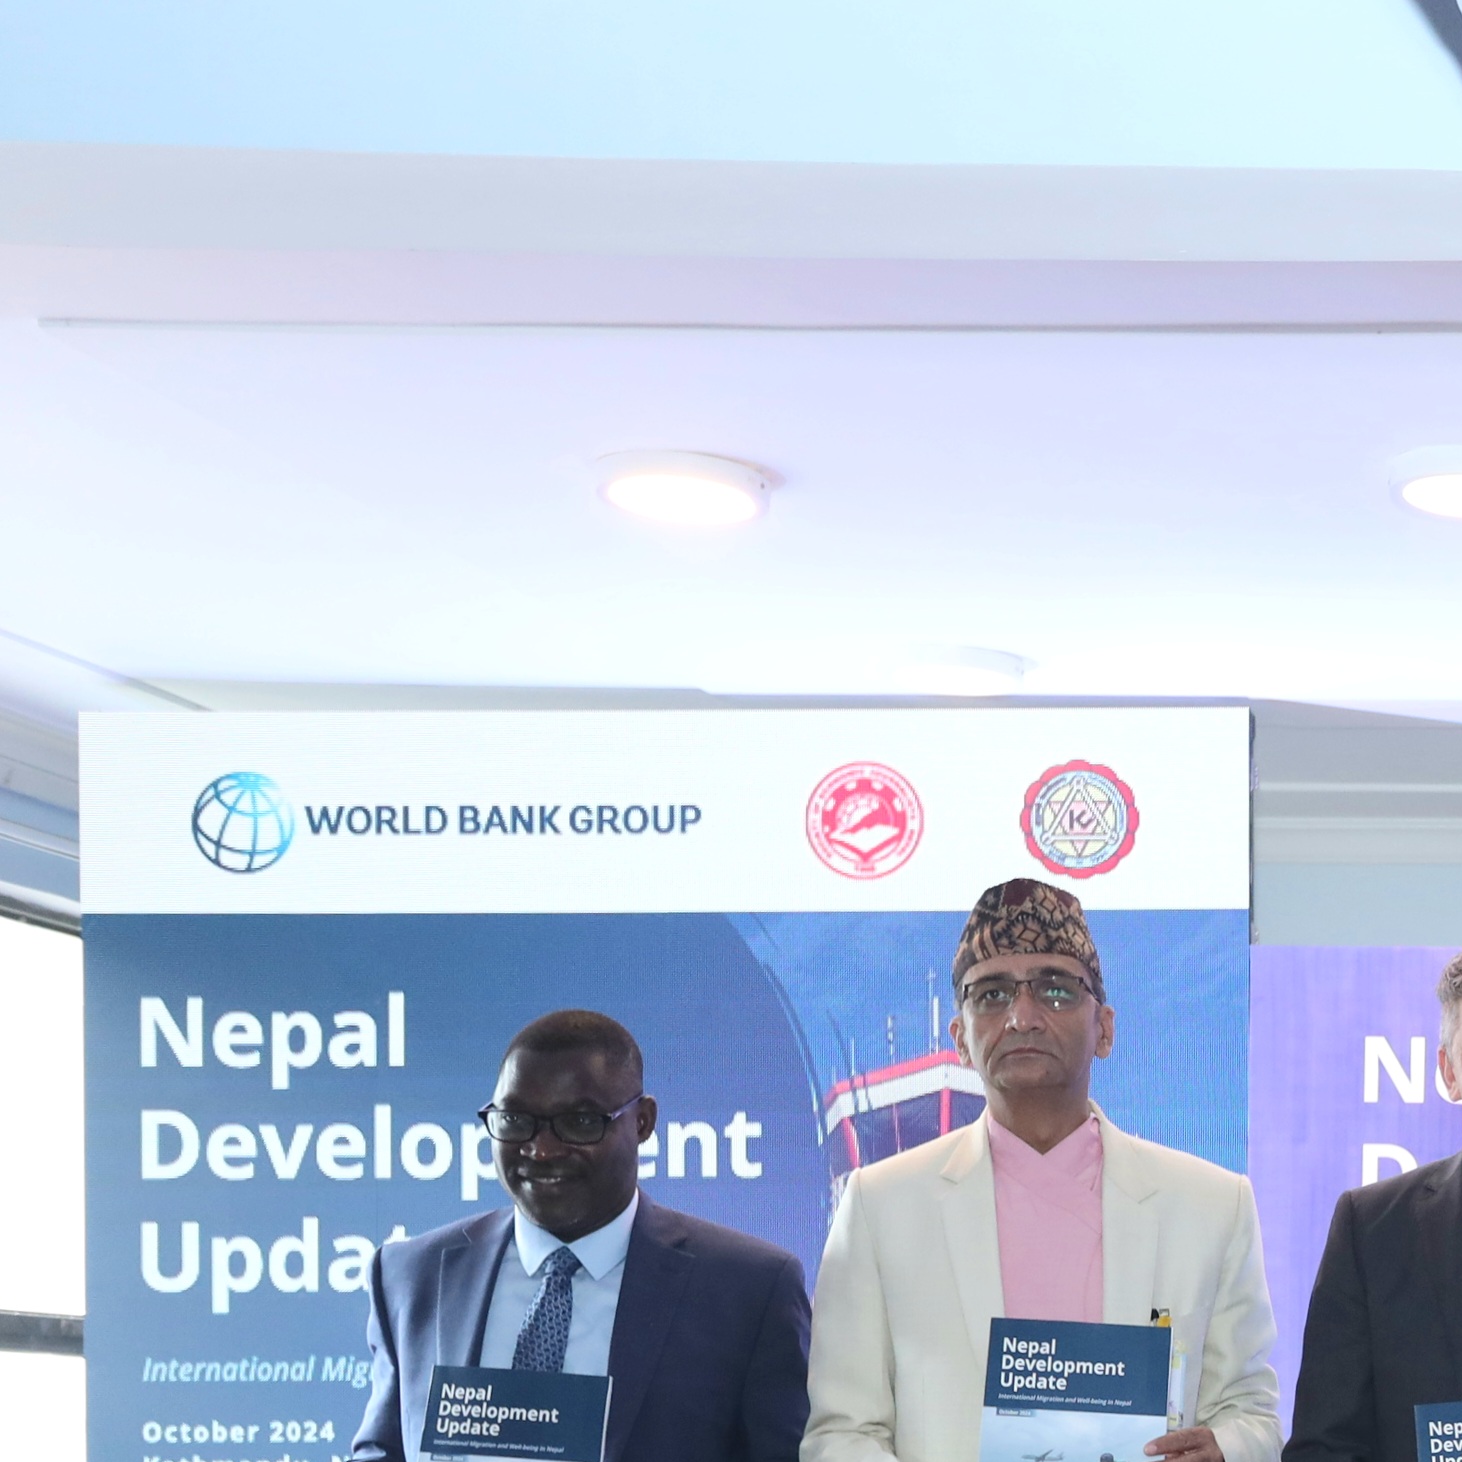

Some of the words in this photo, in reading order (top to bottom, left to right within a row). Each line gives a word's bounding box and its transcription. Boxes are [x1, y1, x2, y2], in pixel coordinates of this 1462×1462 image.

[305, 804, 449, 836] WORLD
[459, 805, 561, 836] BANK
[569, 804, 702, 836] GROUP
[139, 991, 406, 1090] Nepal
[139, 1105, 763, 1201] Developnt
[140, 1216, 410, 1314] Upda
[1003, 1337, 1056, 1358] Nepal
[142, 1356, 316, 1382] International
[1001, 1355, 1125, 1377] Development
[441, 1383, 492, 1401] Nepal
[1000, 1372, 1067, 1392] Update
[998, 1393, 1036, 1401] International
[1036, 1395, 1064, 1403] Migration
[438, 1401, 559, 1423] Development
[142, 1420, 260, 1443] October
[269, 1420, 336, 1443] 2024
[436, 1418, 500, 1437] Update
